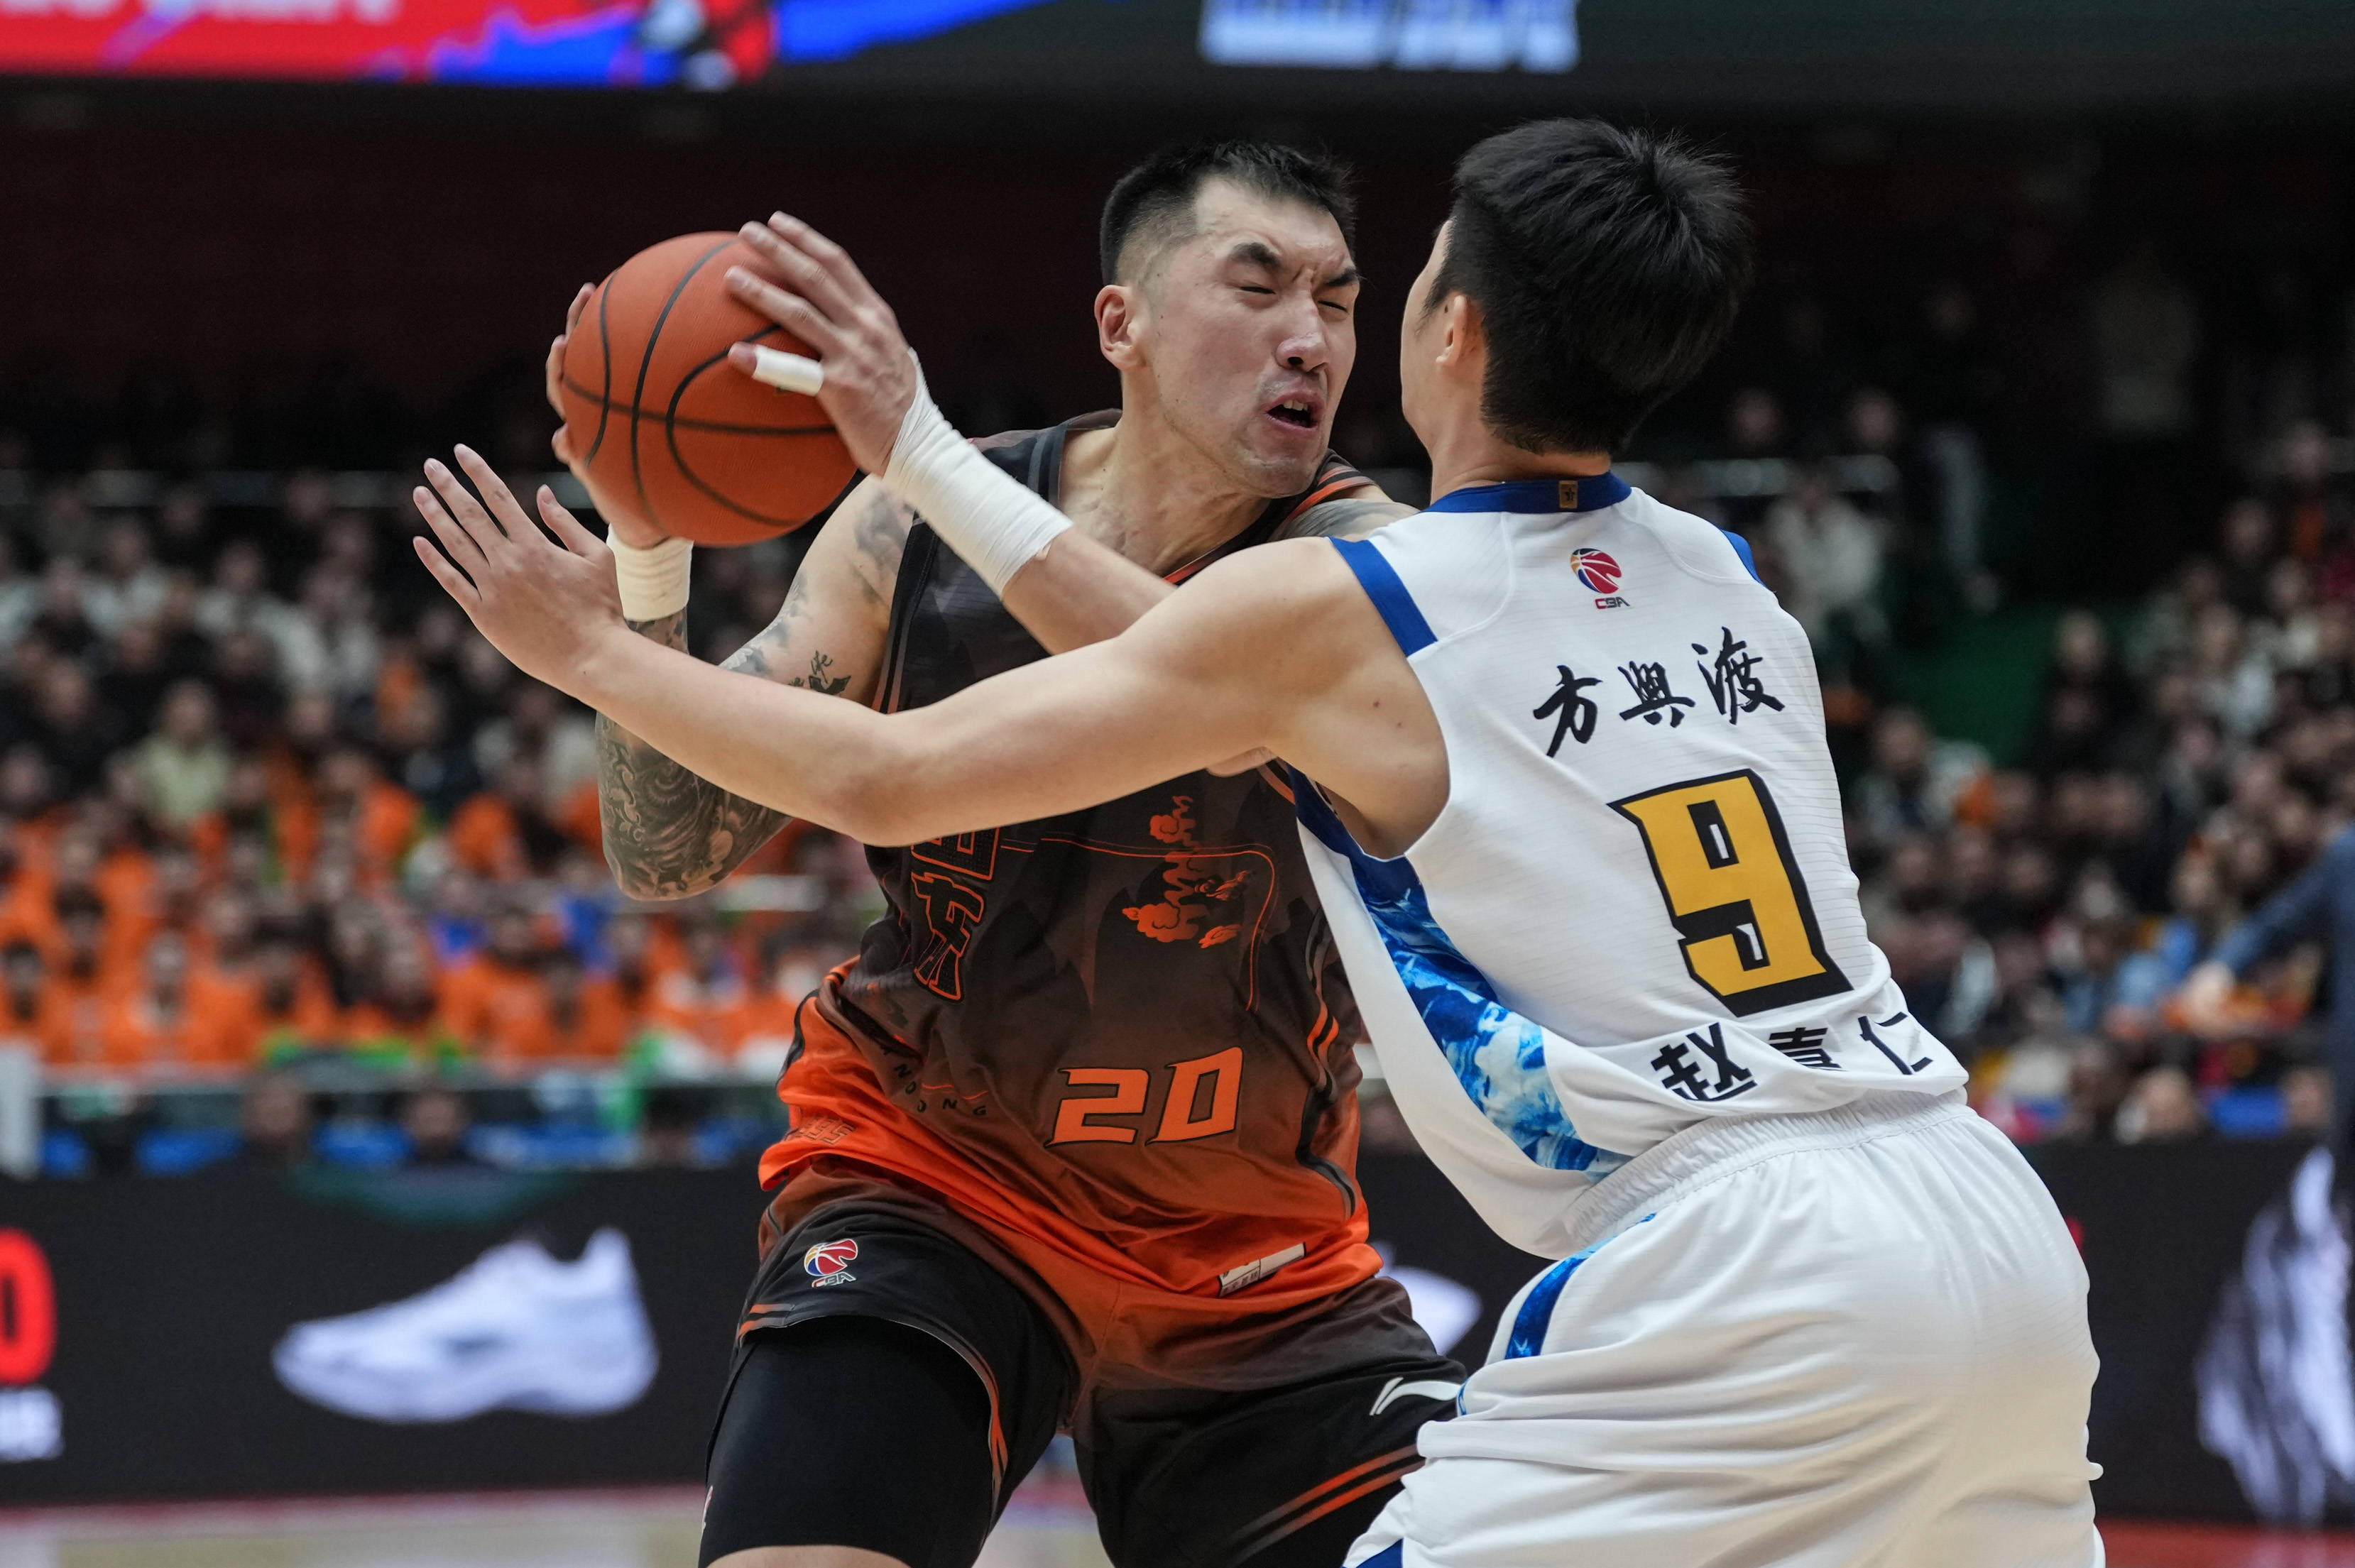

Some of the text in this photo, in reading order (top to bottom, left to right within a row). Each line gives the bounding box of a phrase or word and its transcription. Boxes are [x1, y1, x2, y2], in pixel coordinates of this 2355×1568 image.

[1595, 596, 1631, 610] CBA
[1606, 768, 1854, 1018] 9
[1043, 1046, 1243, 1149] 20
